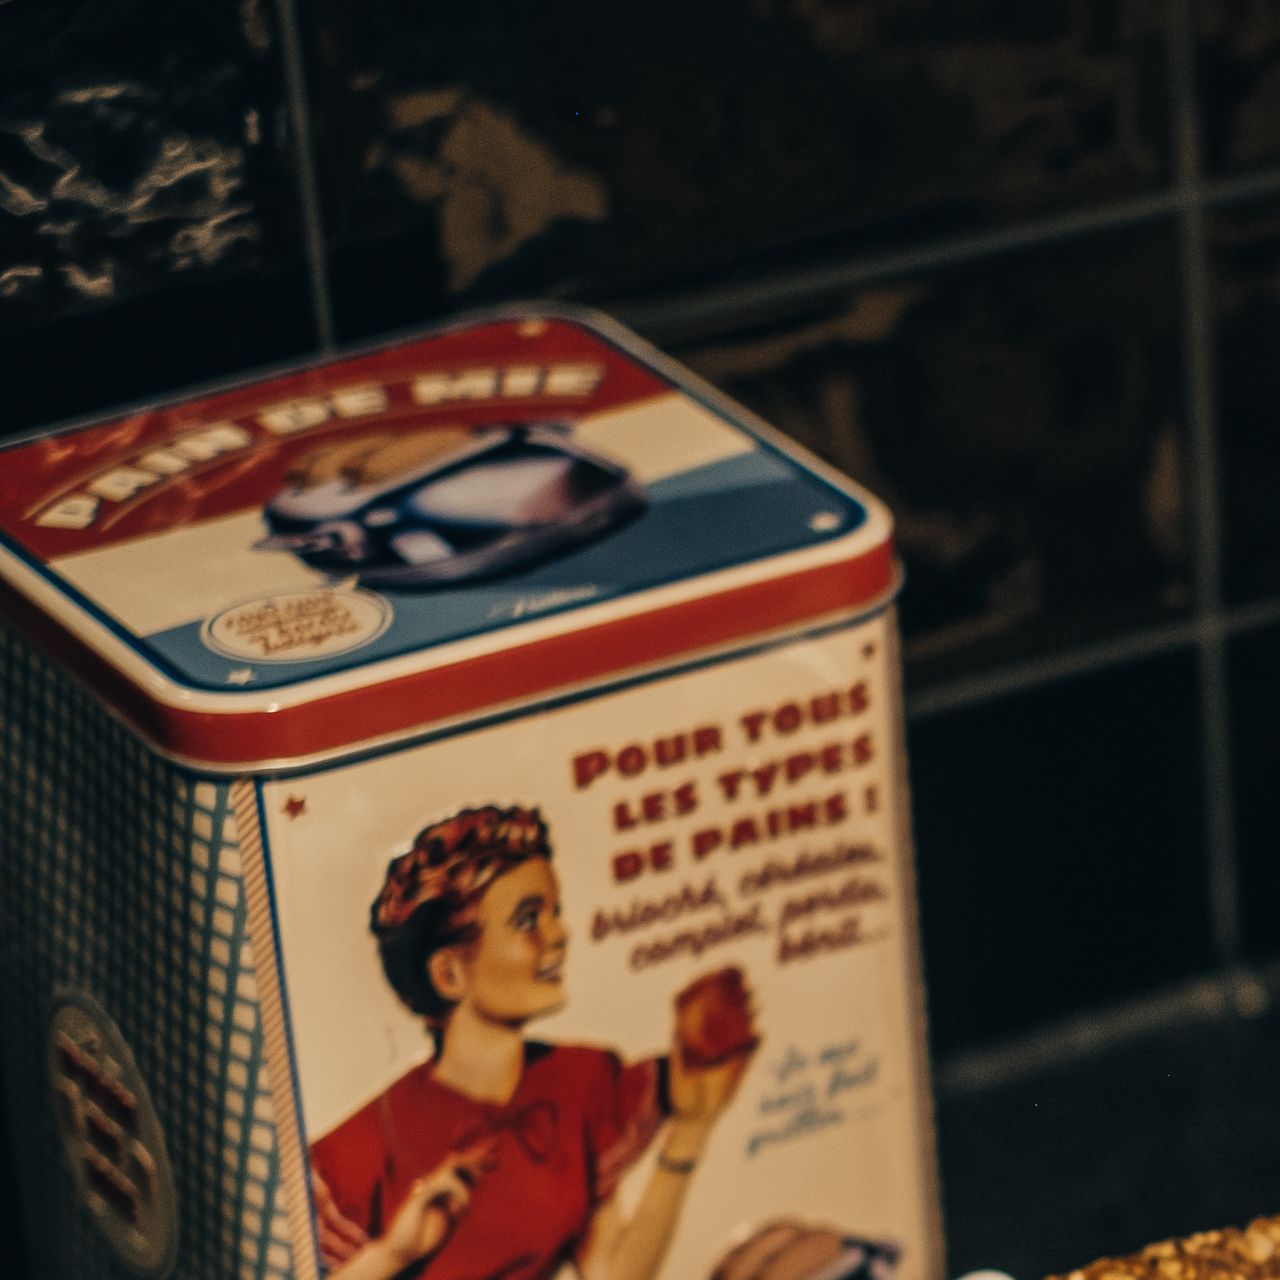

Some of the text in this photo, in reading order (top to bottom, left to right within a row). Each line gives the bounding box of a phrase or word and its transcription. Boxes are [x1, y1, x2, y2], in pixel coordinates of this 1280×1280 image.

[36, 363, 602, 530] PAIN DE MIE
[572, 680, 870, 790] POUR TOUS
[613, 732, 874, 832] LES TYPES
[612, 840, 673, 884] DE
[691, 791, 847, 861] PAINS
